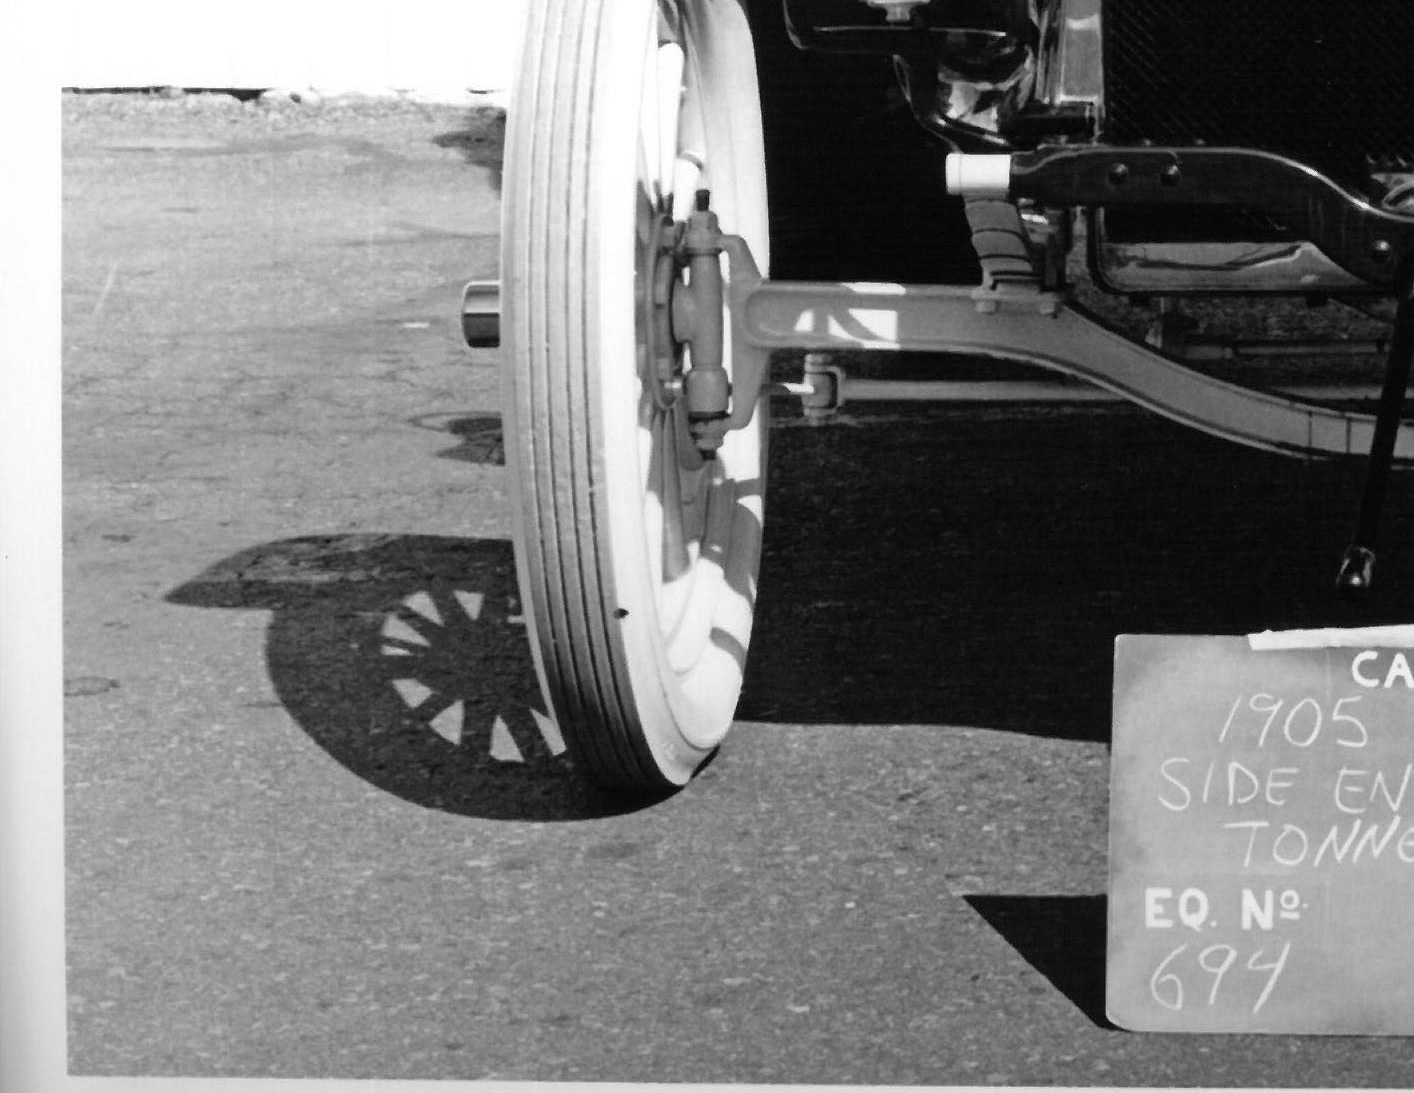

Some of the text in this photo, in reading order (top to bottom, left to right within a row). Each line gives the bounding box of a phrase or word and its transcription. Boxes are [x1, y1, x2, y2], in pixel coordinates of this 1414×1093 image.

[1218, 693, 1368, 748] 1905
[1157, 757, 1299, 810] SIDE
[1150, 942, 1290, 1013] 694
